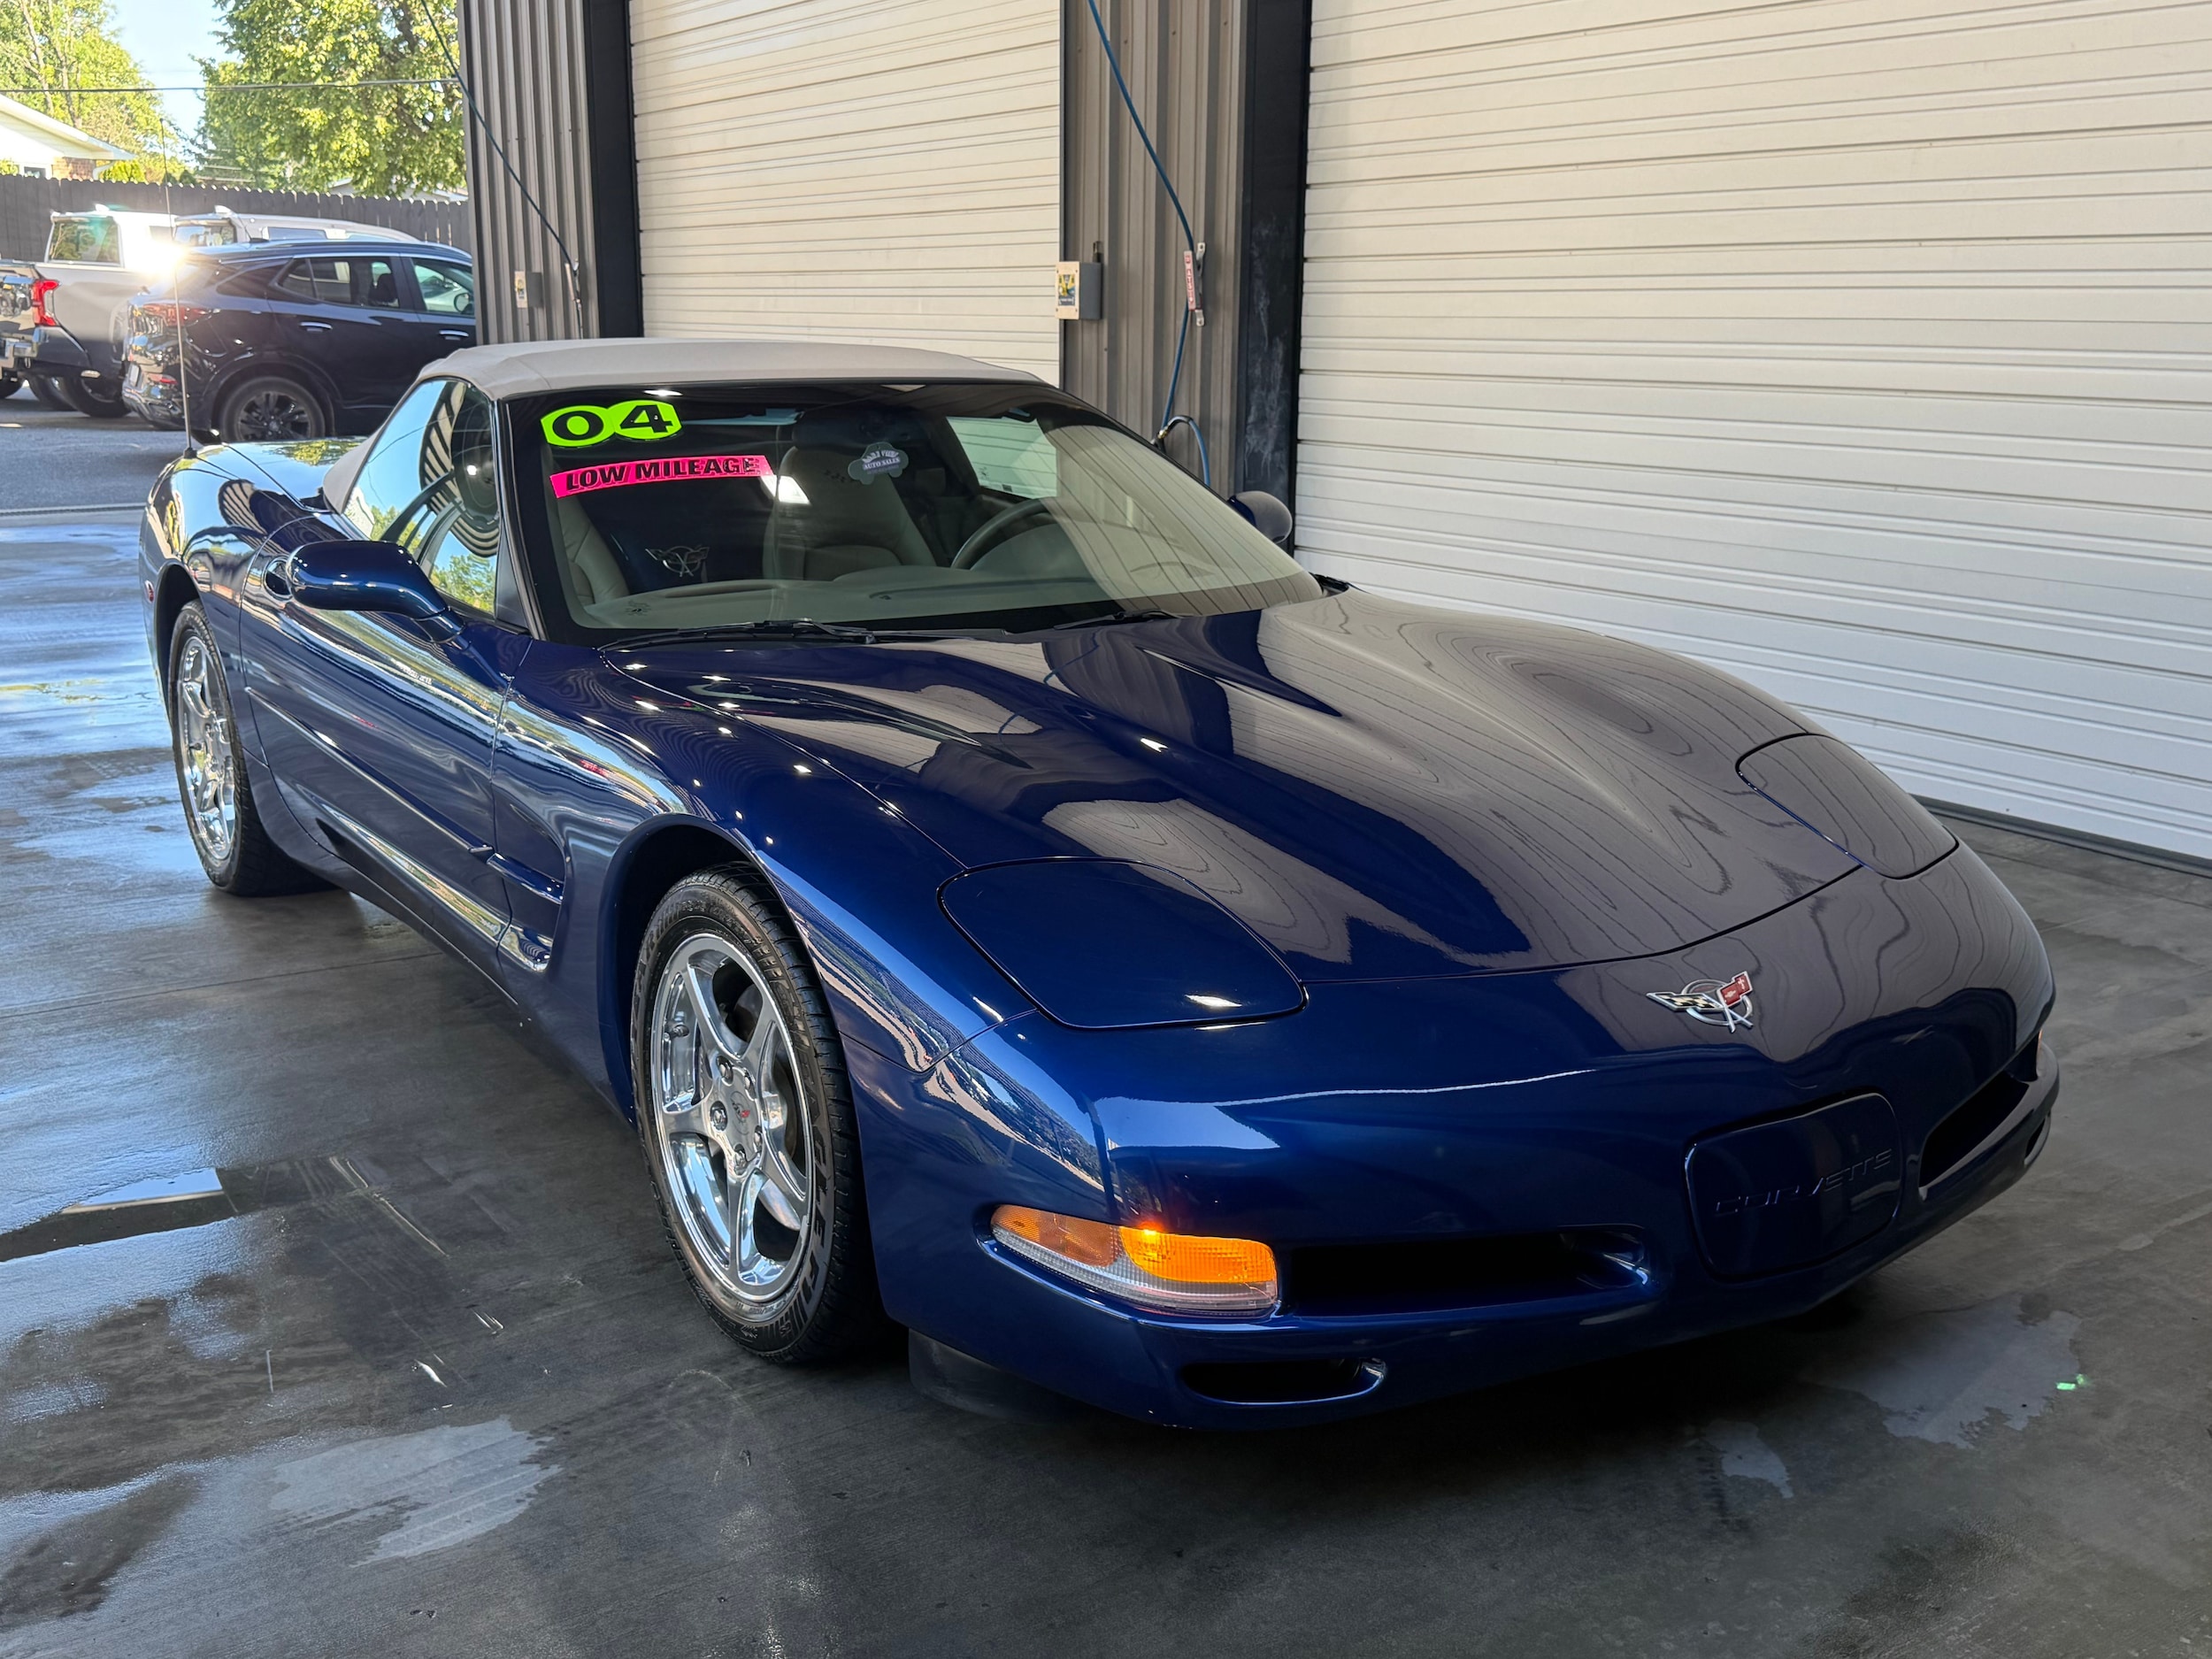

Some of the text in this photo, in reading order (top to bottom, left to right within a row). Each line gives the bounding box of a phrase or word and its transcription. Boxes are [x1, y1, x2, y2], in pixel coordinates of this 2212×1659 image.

[552, 404, 673, 441] 04
[566, 457, 762, 491] LOW MILEAGE
